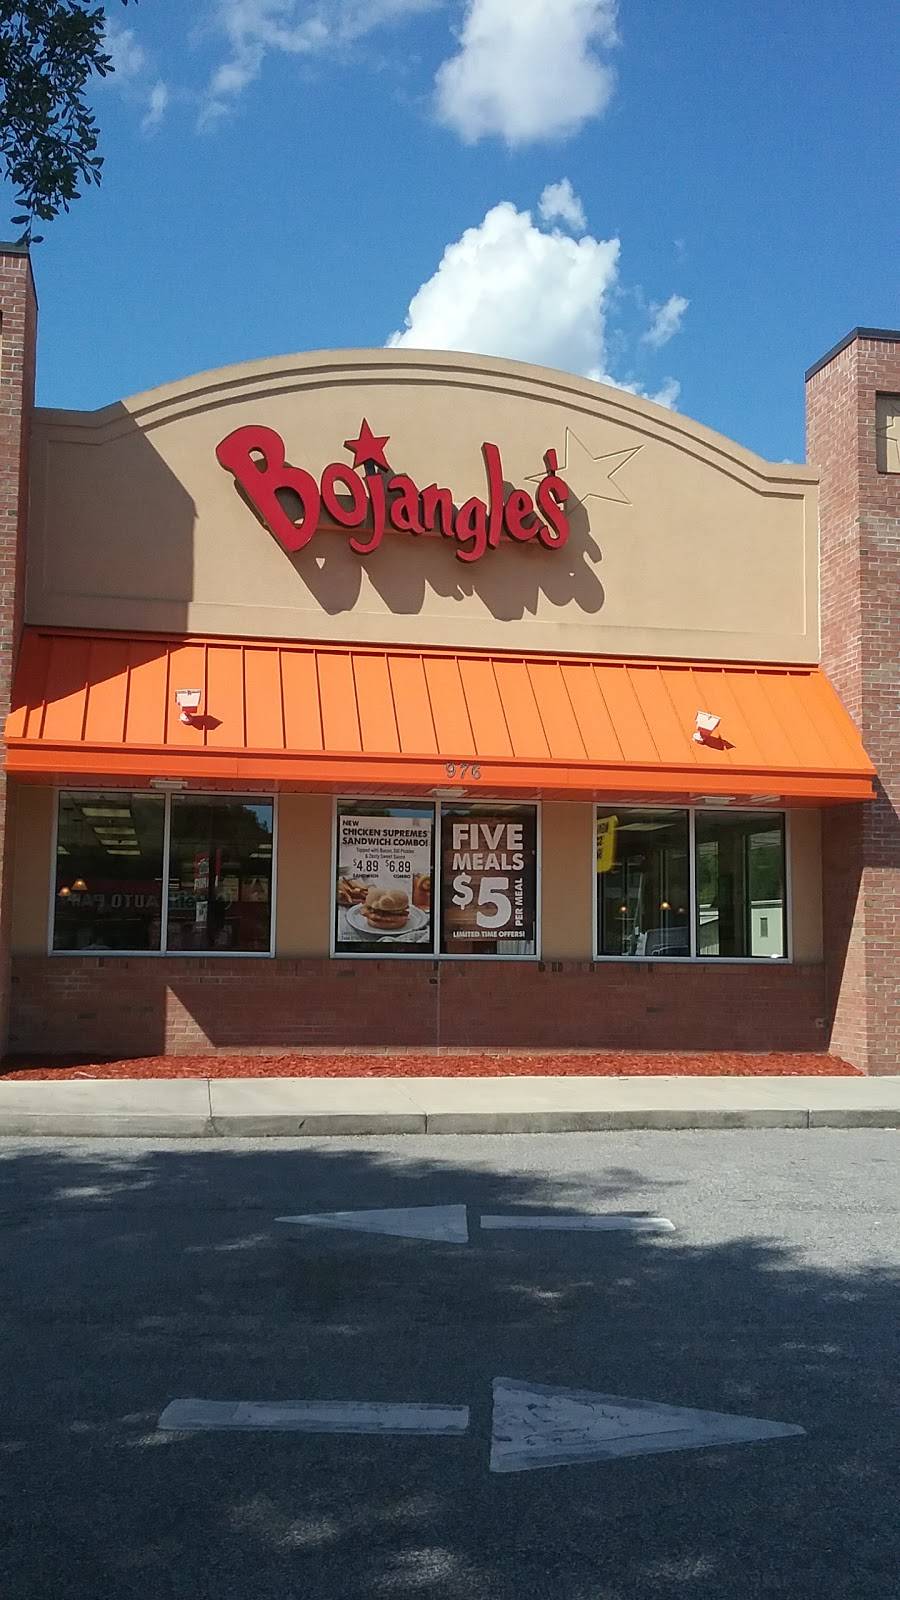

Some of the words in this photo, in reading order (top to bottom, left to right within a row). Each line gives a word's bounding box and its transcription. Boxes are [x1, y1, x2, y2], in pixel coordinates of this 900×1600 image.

[446, 762, 481, 779] 976
[342, 828, 381, 837] CHICKEN
[383, 830, 428, 838] SUPREMES
[452, 824, 523, 850] FIVE
[342, 837, 391, 846] SANDWICH
[393, 838, 428, 847] COMBO!
[353, 859, 379, 872] $4.89
[385, 859, 411, 873] $6.89
[452, 853, 524, 870] MEALS
[452, 872, 512, 928] $5
[515, 878, 523, 906] MEAL
[515, 908, 523, 926] PER
